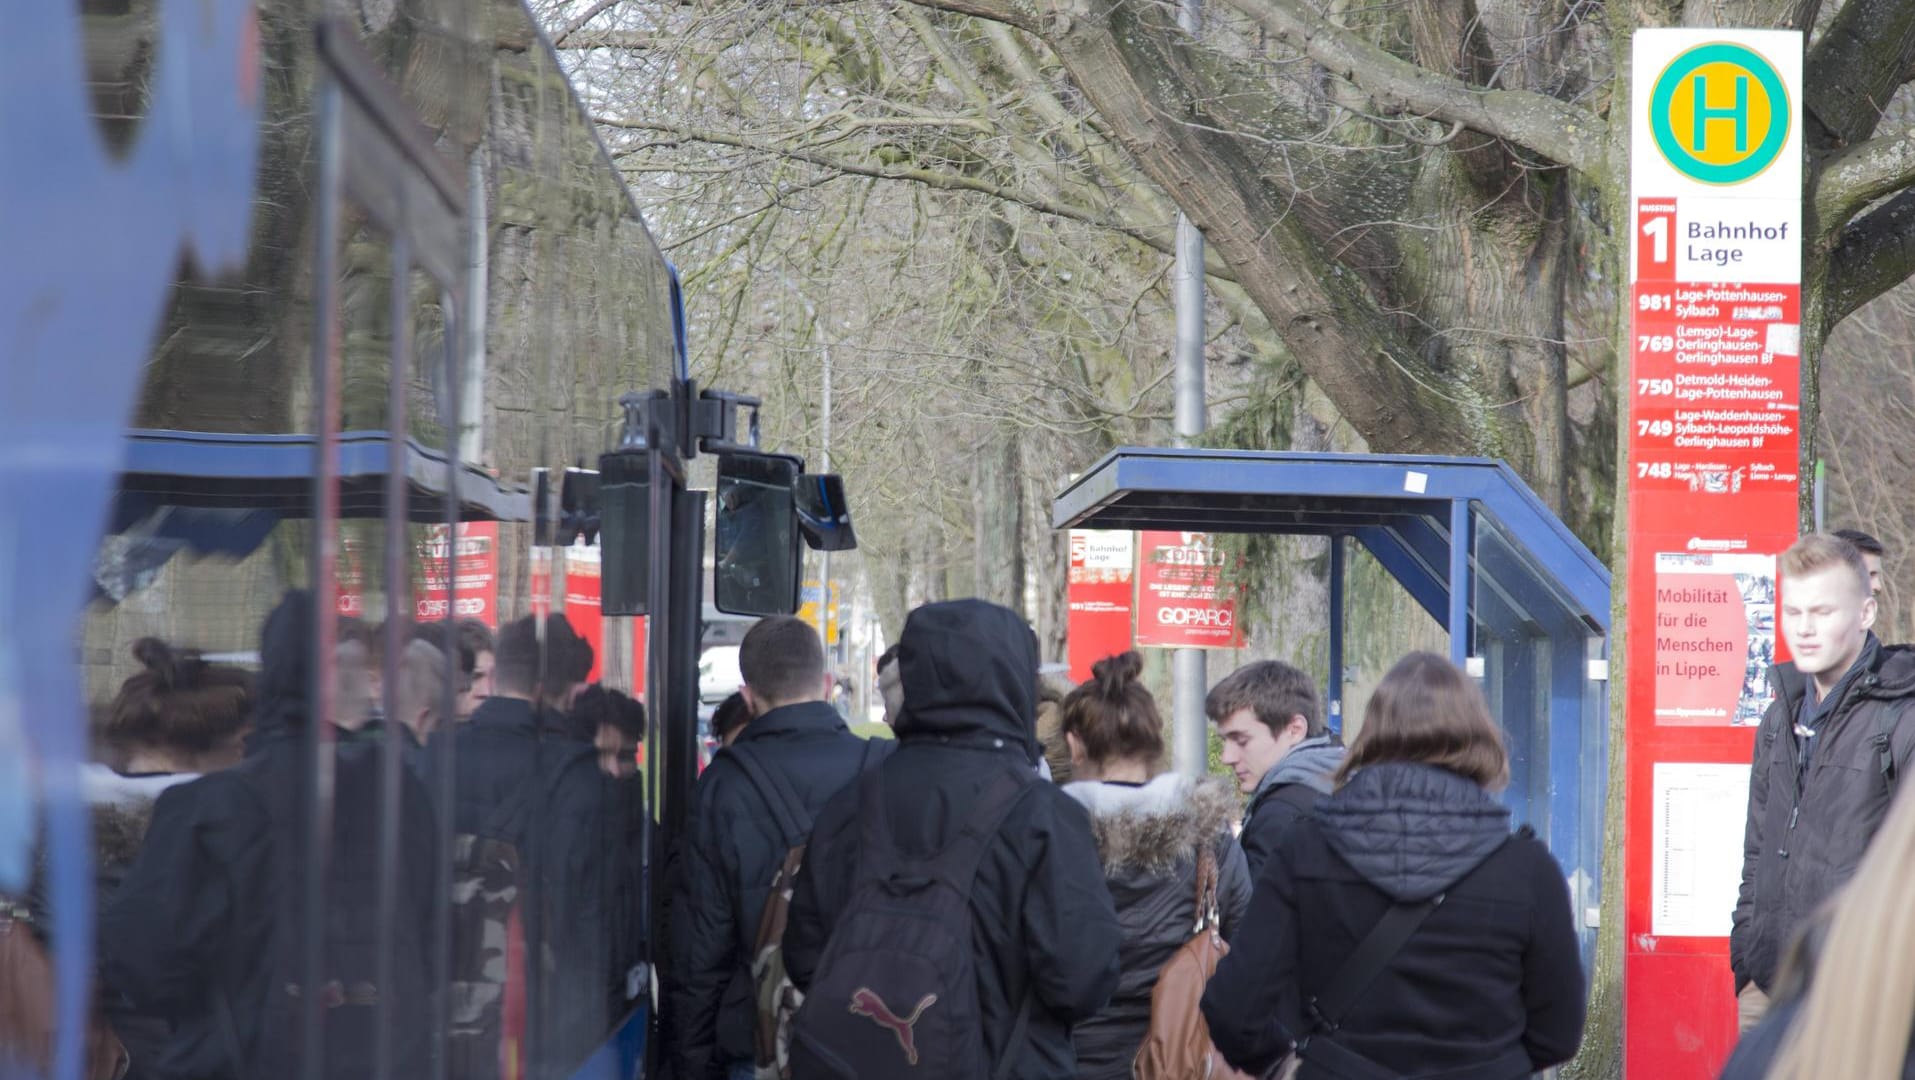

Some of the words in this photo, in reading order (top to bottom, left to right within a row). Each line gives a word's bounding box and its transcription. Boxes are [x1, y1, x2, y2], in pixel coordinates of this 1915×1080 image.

[1693, 75, 1748, 152] H
[1688, 221, 1788, 239] Bahnhof
[1642, 217, 1668, 263] 1
[1688, 246, 1743, 266] Lage
[1639, 295, 1671, 310] 981
[1676, 289, 1787, 302] Lage-Pottenhausen-
[1676, 305, 1719, 319] Sylbach
[1676, 326, 1758, 339] (Lemgo)-Lage-
[1638, 335, 1674, 352] 769
[1676, 339, 1762, 352] Oerlinghausen-
[1676, 352, 1758, 365] Oerlinghausen
[1761, 352, 1773, 364] Bf
[1638, 379, 1673, 395] 750
[1676, 374, 1772, 386] Detmold-Heiden-
[1676, 387, 1783, 401] Lage-Pottenhausen
[1675, 410, 1785, 422] Lage-Waddenhausen-
[1637, 420, 1673, 436] 749
[1675, 422, 1792, 435] Sylbach-Leopoldshöhe-
[1674, 436, 1750, 449] Oerlinghausen
[1752, 436, 1764, 447] Bf
[1637, 462, 1672, 478] 748
[1090, 545, 1127, 553] Bahnhof
[1090, 554, 1110, 562] Lage
[1657, 588, 1728, 604] Mobilität
[1158, 606, 1232, 626] GOPARC!
[1657, 613, 1677, 627] für
[1684, 613, 1707, 627] die
[1657, 637, 1733, 652] Menschen
[1656, 662, 1670, 676] in
[1676, 662, 1720, 679] Lippe.
